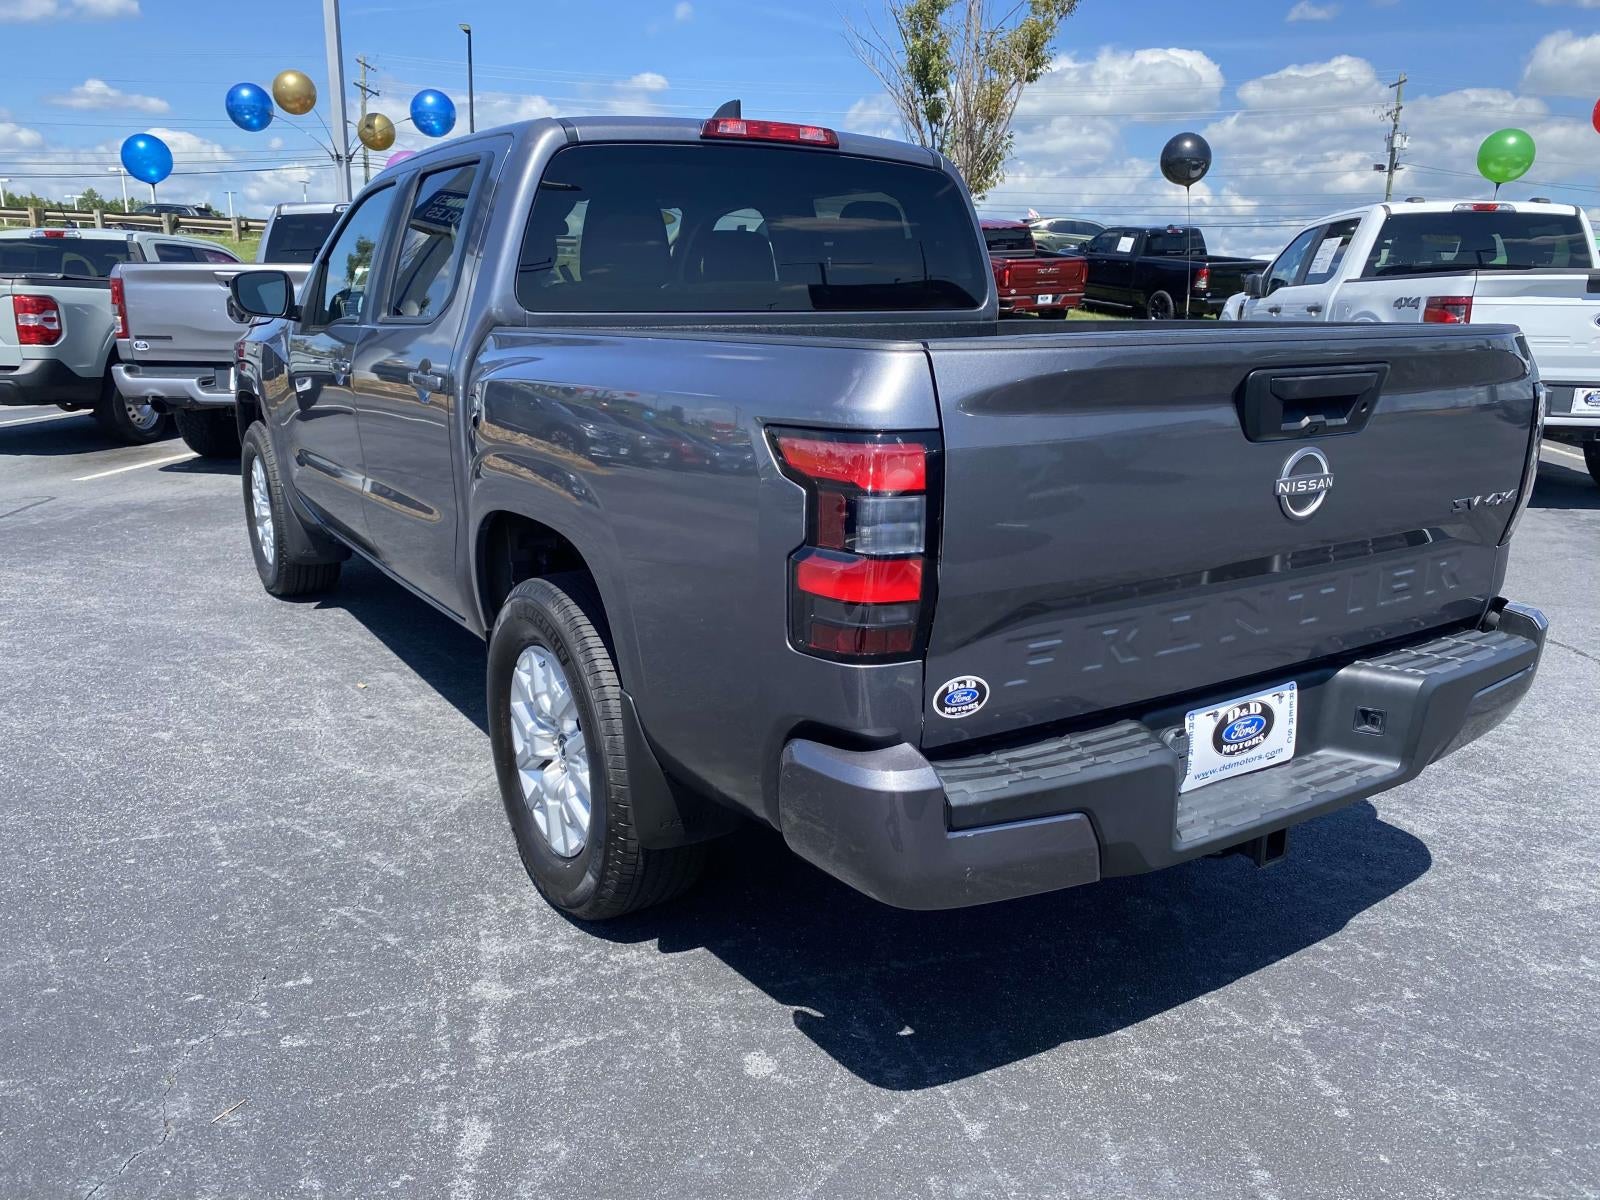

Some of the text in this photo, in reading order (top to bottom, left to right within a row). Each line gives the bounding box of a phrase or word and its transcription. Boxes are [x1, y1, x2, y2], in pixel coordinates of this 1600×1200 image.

[1278, 476, 1334, 493] NISSAN
[1452, 495, 1481, 512] SV
[1002, 552, 1464, 687] FRONTIER
[948, 680, 977, 693] D&D
[944, 701, 979, 714] MOTORS
[951, 691, 973, 704] Ford
[1288, 684, 1296, 725] GREER
[1226, 702, 1262, 724] D&D
[1230, 719, 1259, 739] Ford
[1221, 733, 1265, 755] MOTORS
[1194, 747, 1283, 780] www.ddmotors.com
